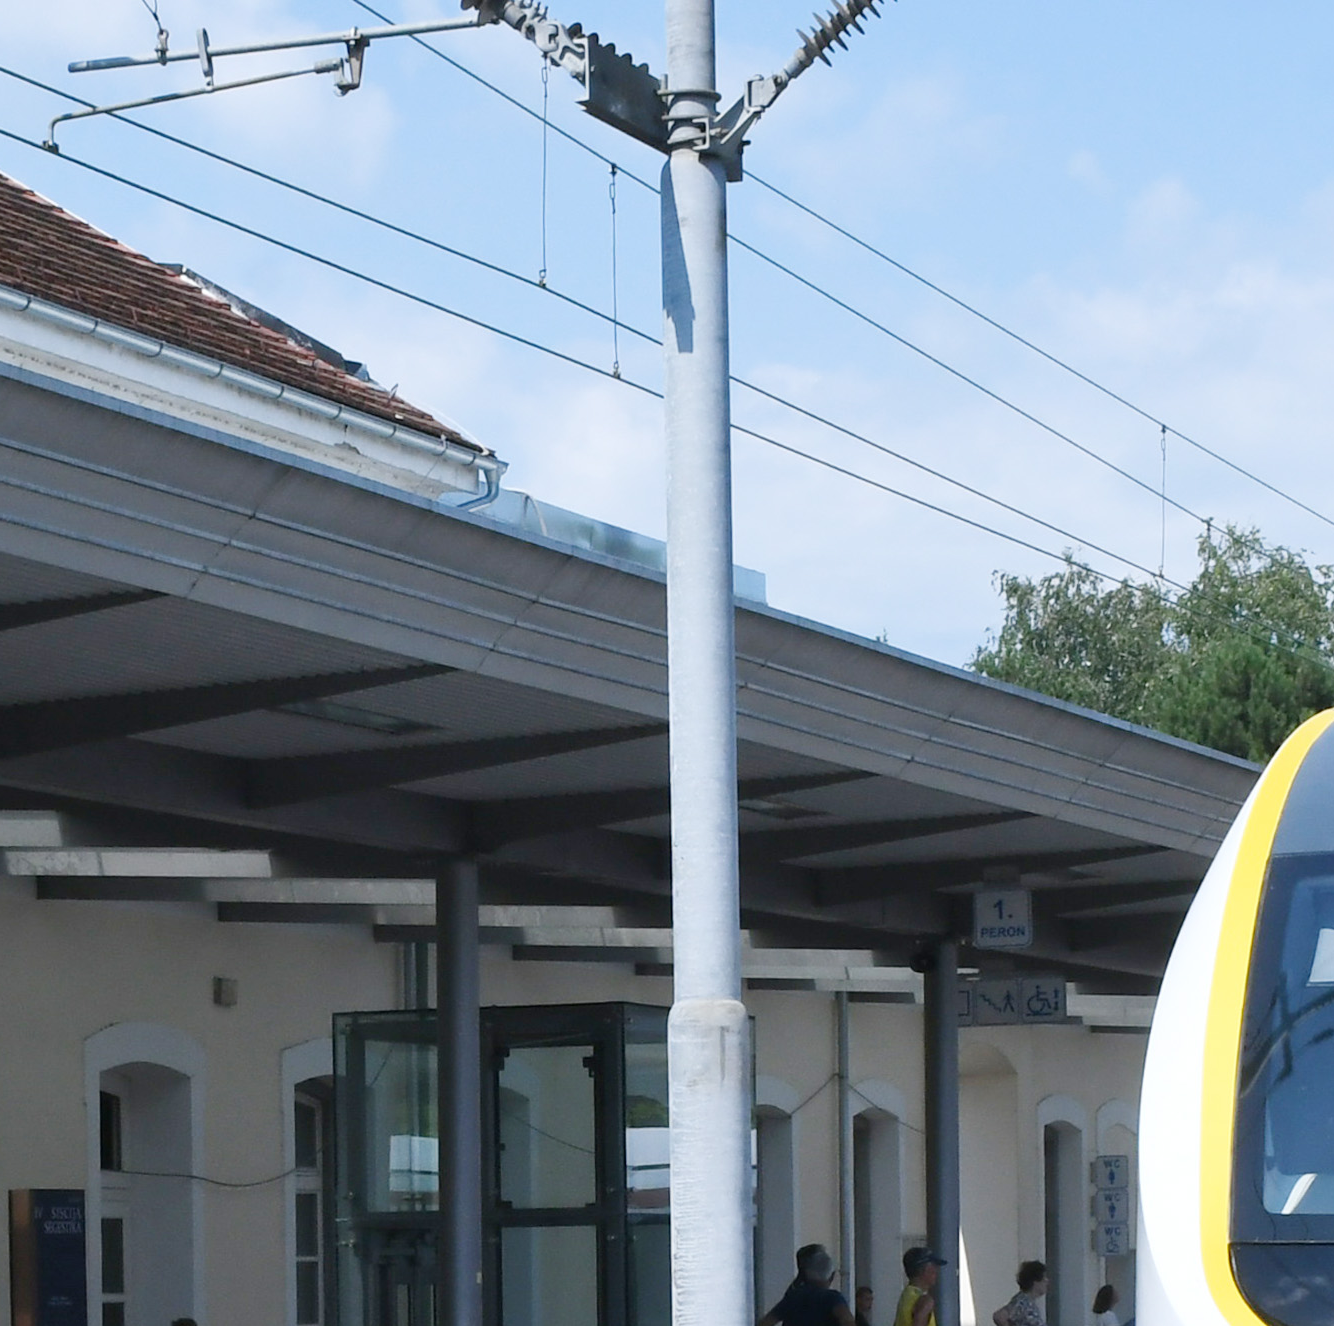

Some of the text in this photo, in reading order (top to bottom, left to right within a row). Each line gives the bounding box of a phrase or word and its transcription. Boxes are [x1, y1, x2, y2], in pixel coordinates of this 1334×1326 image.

[992, 899, 1013, 920] 1.
[980, 926, 1025, 939] PERON
[1103, 1159, 1120, 1168] WC
[1104, 1193, 1121, 1202] WC
[1104, 1226, 1121, 1236] WC
